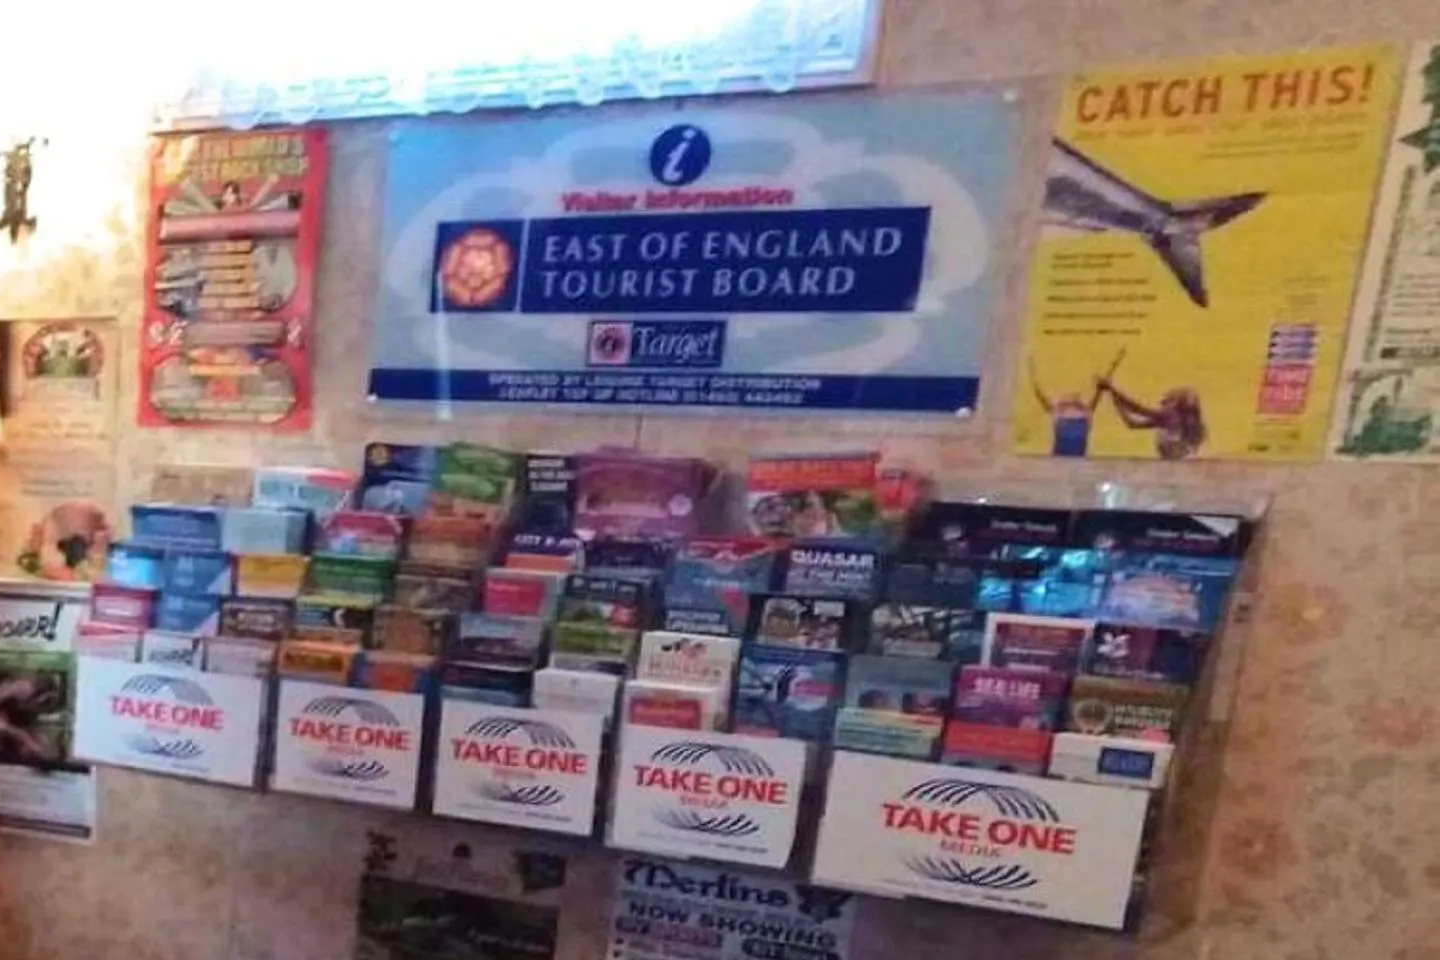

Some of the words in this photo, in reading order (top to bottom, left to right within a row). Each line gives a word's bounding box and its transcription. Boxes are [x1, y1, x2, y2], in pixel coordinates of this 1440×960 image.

[1076, 77, 1223, 124] CATCH
[1243, 65, 1376, 110] THIS!
[561, 191, 637, 213] Visitor
[645, 187, 795, 209] Information
[543, 234, 627, 262] EAST
[640, 231, 691, 260] OF
[702, 227, 903, 260] ENGLAND
[542, 267, 700, 298] TOURIST
[711, 266, 857, 297] BOARD
[632, 325, 720, 364] Target
[790, 549, 875, 570] QUASAR
[111, 695, 168, 721] TAKE
[171, 705, 224, 730] ONE
[290, 717, 351, 743] TAKE
[354, 726, 411, 750] ONE
[451, 738, 520, 766] TAKE
[525, 748, 588, 774] ONE
[633, 765, 710, 793] TAKE
[717, 775, 789, 804] ONE
[881, 803, 981, 841] TAKE
[987, 819, 1078, 854] ONE
[629, 901, 690, 924] NOW
[699, 913, 837, 948] SHOWING
